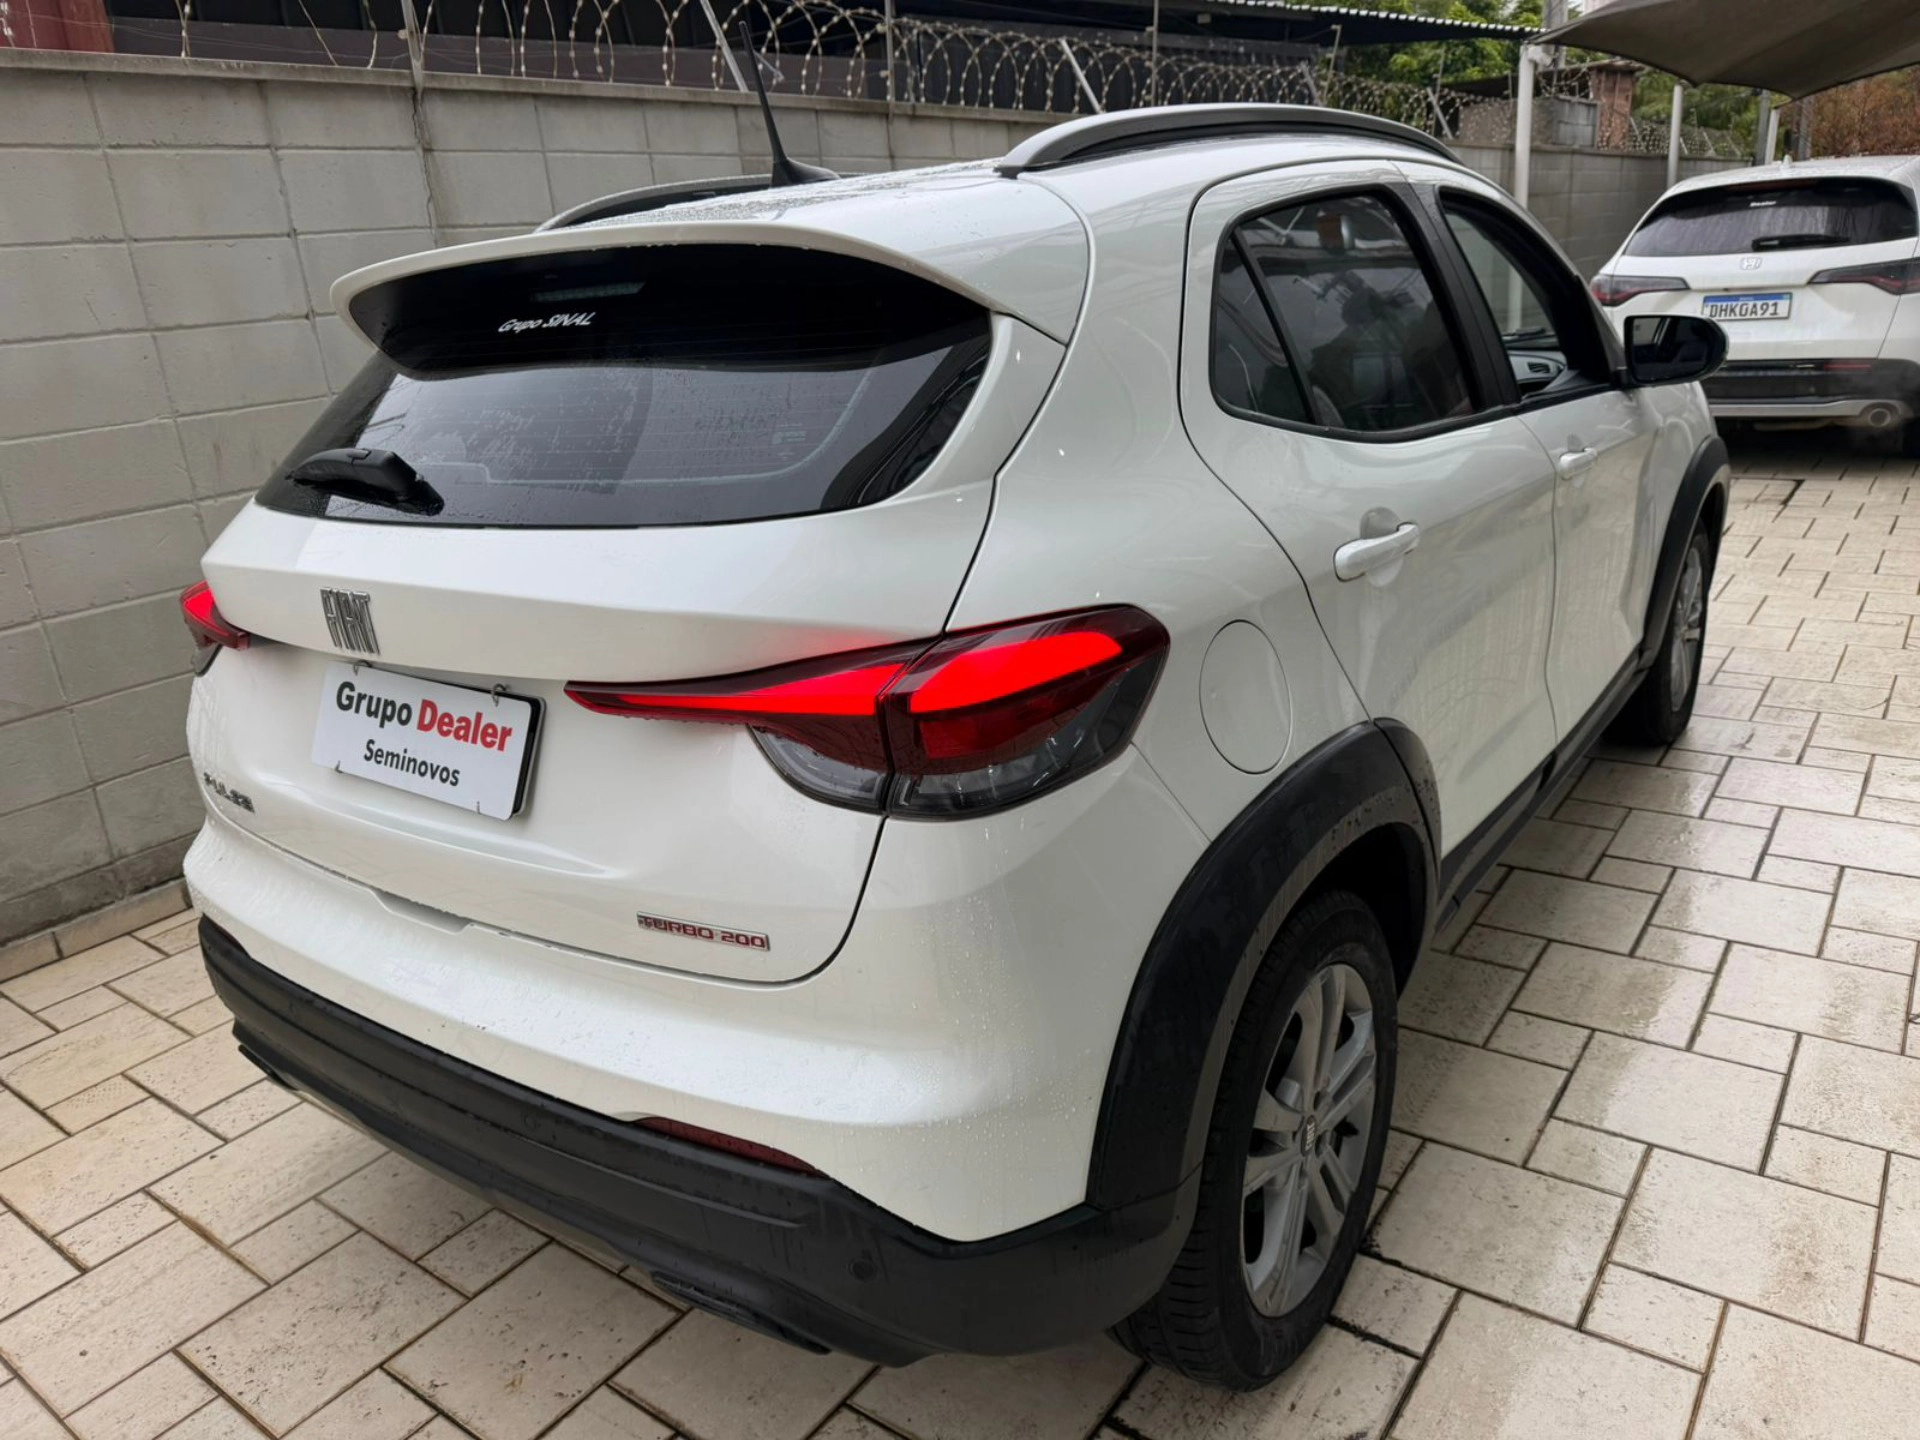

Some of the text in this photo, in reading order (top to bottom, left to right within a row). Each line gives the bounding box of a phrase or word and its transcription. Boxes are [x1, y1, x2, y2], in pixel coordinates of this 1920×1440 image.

[498, 312, 596, 333] Grupo SINAL
[320, 588, 381, 656] FIAT
[336, 681, 513, 752] Grupo Dealer
[363, 738, 461, 787] Seminovos
[638, 914, 766, 949] TURBO 200
